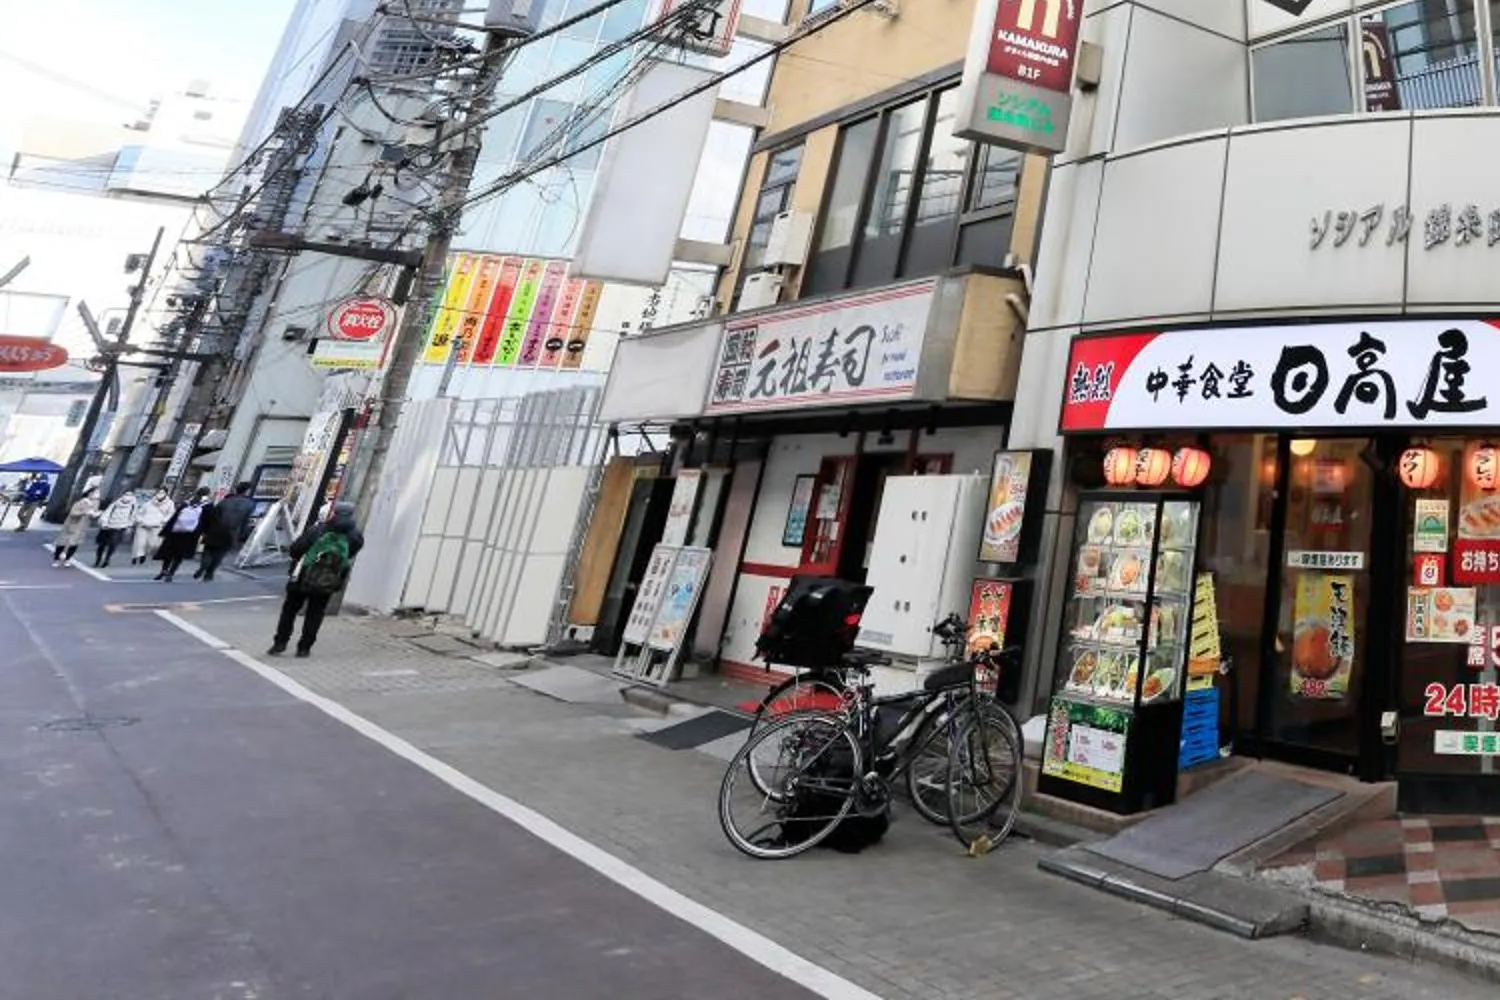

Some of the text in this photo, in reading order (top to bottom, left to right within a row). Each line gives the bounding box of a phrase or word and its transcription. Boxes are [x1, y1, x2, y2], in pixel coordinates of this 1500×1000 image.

[997, 29, 1069, 60] KAMAKURA
[1017, 65, 1042, 82] B1F
[1145, 328, 1488, 420] 中華食堂 日高屋
